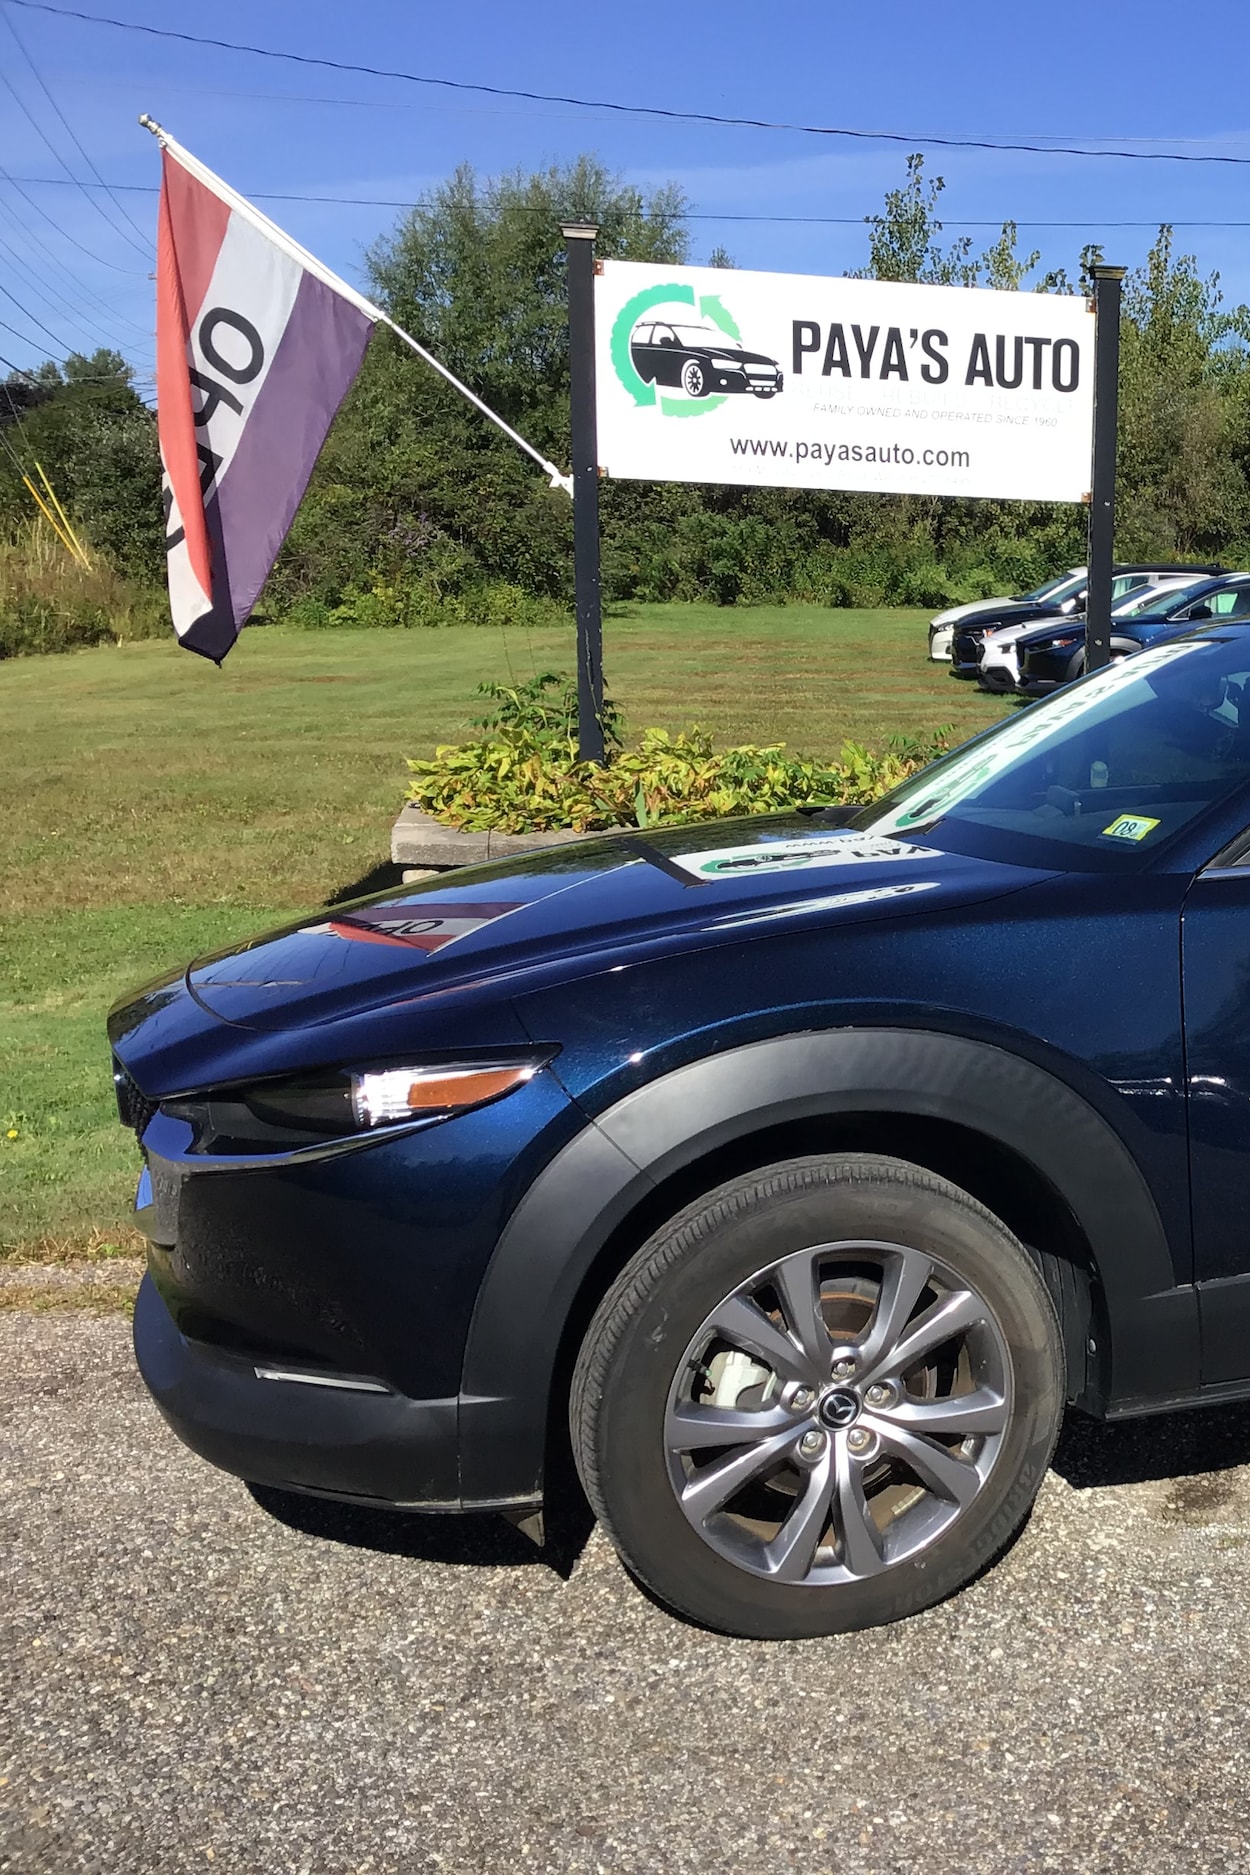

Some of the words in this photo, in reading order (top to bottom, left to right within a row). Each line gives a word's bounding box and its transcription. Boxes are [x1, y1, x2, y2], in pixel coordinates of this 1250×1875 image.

[792, 319, 949, 384] PAYA'S
[964, 333, 1080, 393] AUTO
[813, 402, 856, 416] FAMILY
[857, 405, 902, 419] OWNED
[904, 408, 929, 420] AND
[931, 410, 993, 424] OPERATED
[995, 414, 1030, 426] SINCE
[1033, 416, 1058, 428] 1960
[730, 438, 970, 468] www.payasauto.com
